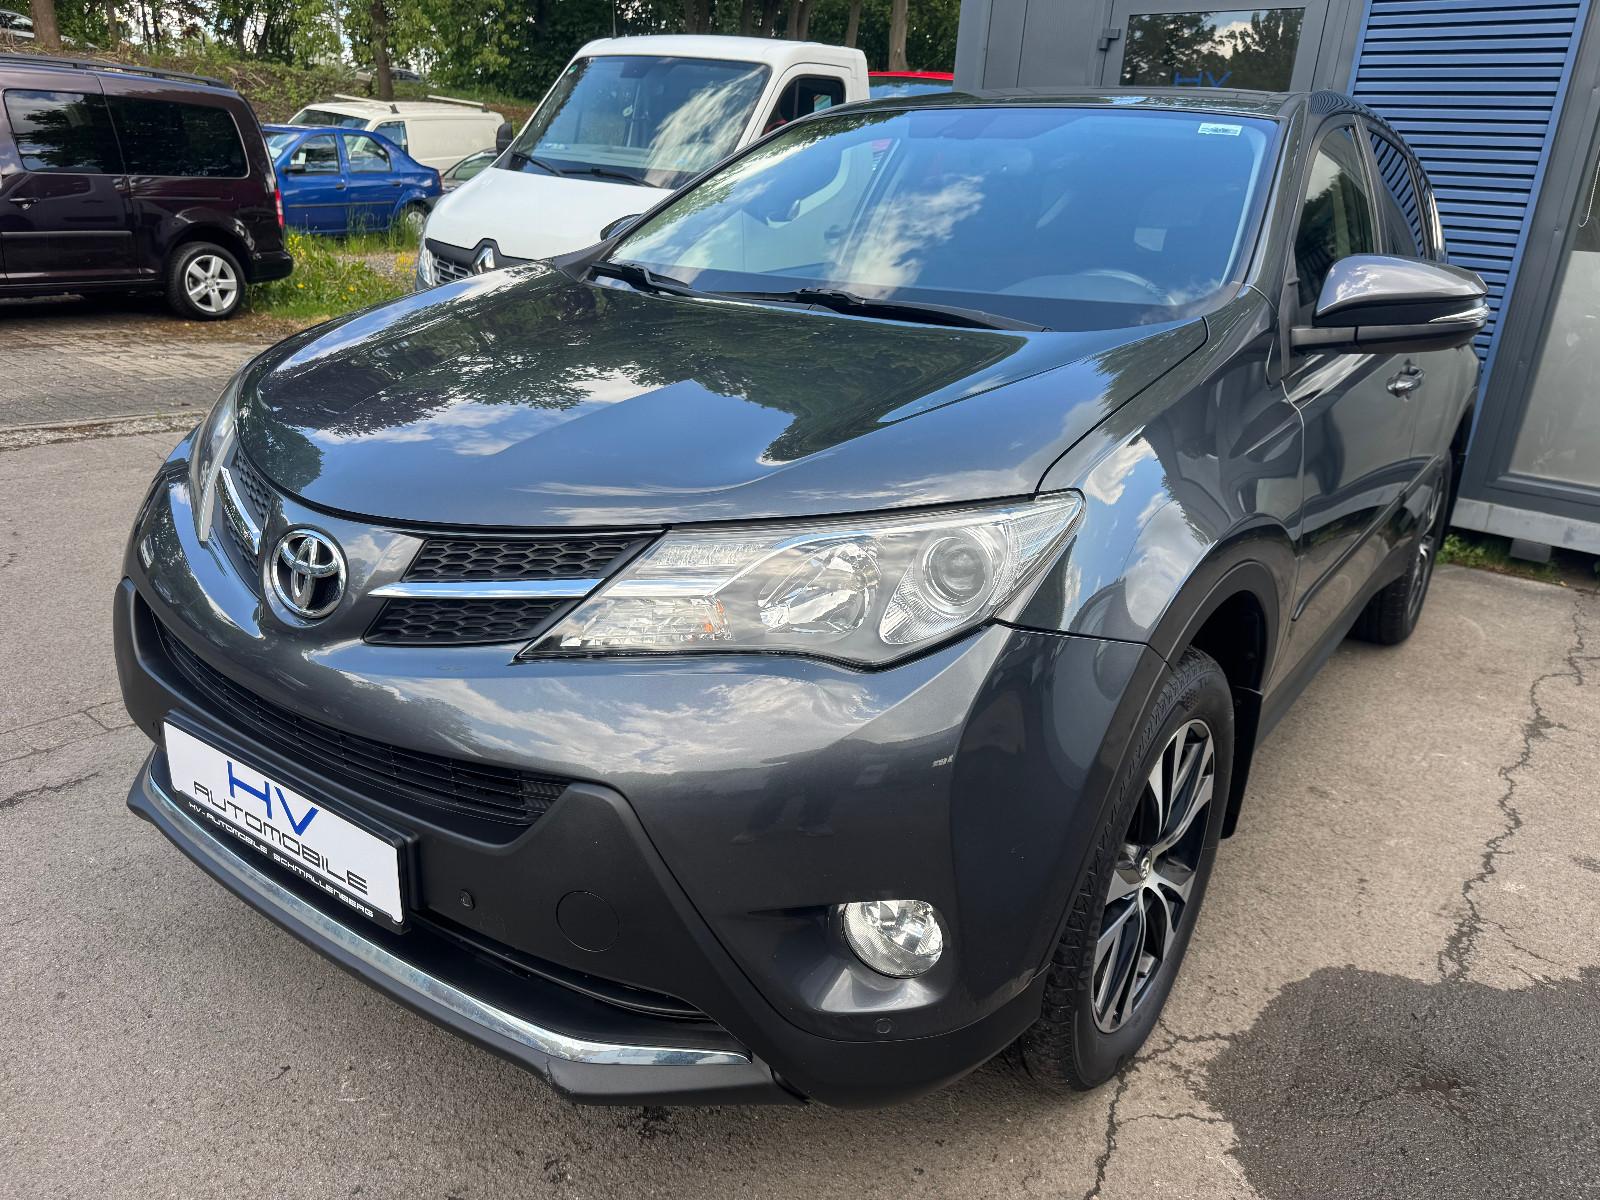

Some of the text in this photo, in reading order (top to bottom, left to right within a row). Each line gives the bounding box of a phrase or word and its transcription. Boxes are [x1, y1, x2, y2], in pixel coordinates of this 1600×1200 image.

[1174, 71, 1233, 88] HV
[227, 760, 319, 836] HV
[193, 781, 368, 895] AUTOMOBILE
[273, 853, 374, 918] SCHMALLENBERG
